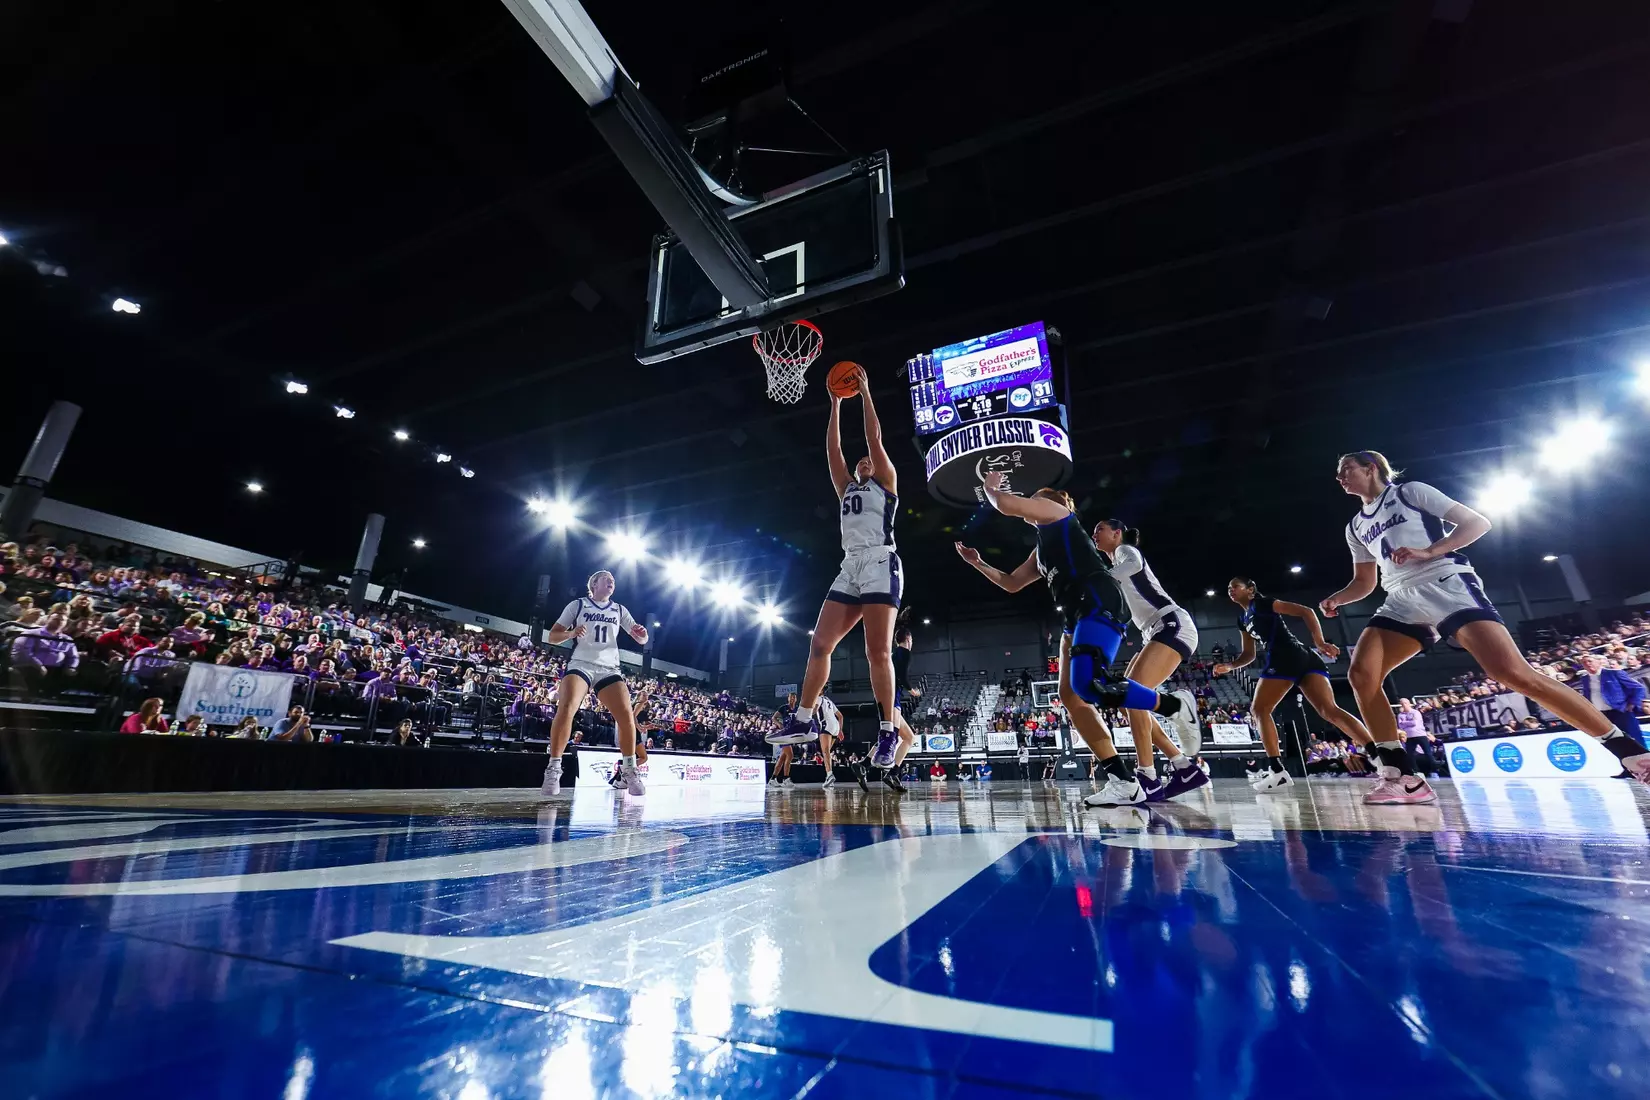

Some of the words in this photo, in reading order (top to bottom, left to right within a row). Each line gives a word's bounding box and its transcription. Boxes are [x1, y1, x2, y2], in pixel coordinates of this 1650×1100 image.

[701, 48, 768, 82] DAKTRONICS
[978, 347, 1037, 367] Godfather's
[980, 363, 1008, 375] Pizza
[1009, 355, 1036, 369] Express
[1034, 382, 1051, 397] 31
[971, 398, 992, 411] 4:18
[916, 408, 933, 424] 39
[941, 424, 982, 460] SNYDER
[983, 419, 1035, 446] CLASSIC
[985, 454, 1010, 471] St.
[842, 494, 863, 515] 50
[1361, 513, 1408, 546] Wildcats
[1380, 536, 1396, 560] 4
[583, 612, 618, 625] Wildcats
[594, 625, 608, 643] 11
[195, 699, 274, 717] Southern
[1432, 699, 1501, 734] K-STATE
